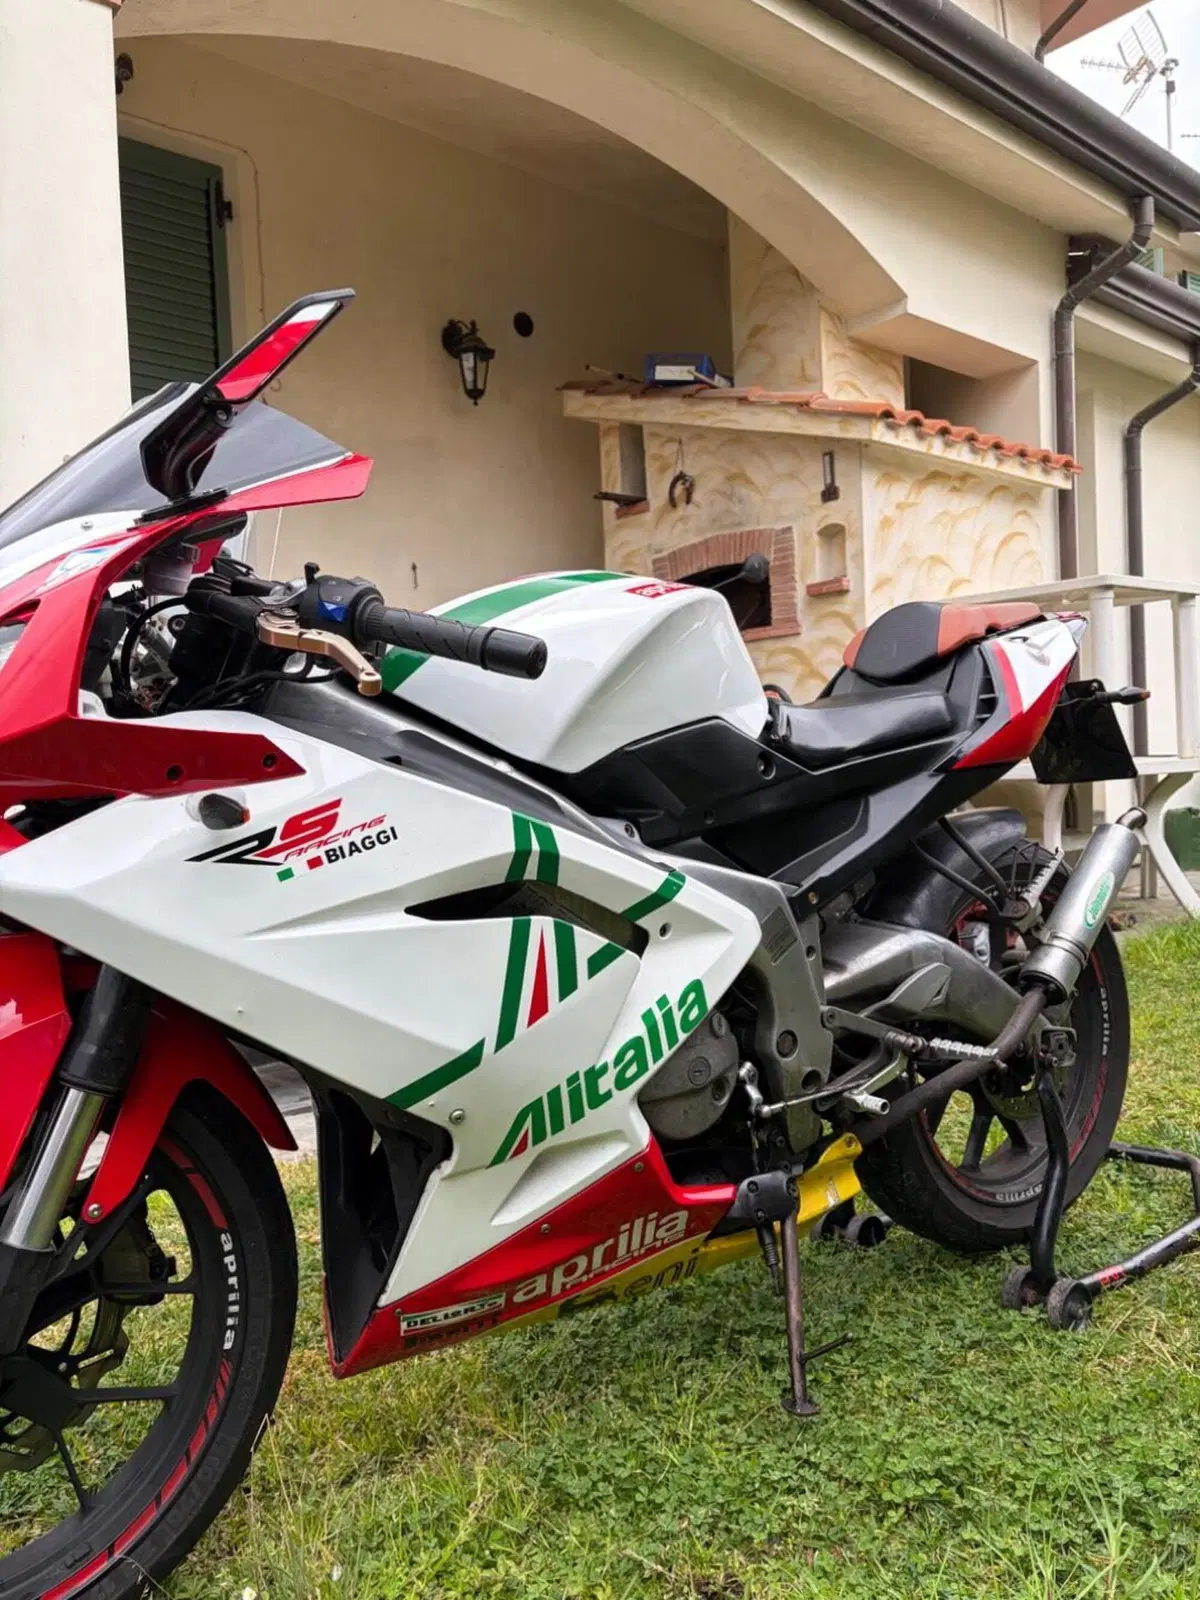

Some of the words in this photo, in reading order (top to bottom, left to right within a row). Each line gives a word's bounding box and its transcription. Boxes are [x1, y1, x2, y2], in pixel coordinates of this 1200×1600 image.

[184, 798, 343, 866] RS
[324, 826, 398, 864] BIAGGI
[486, 978, 709, 1169] Alitalia
[219, 1230, 238, 1350] aprilia
[513, 1210, 689, 1297] aprilia
